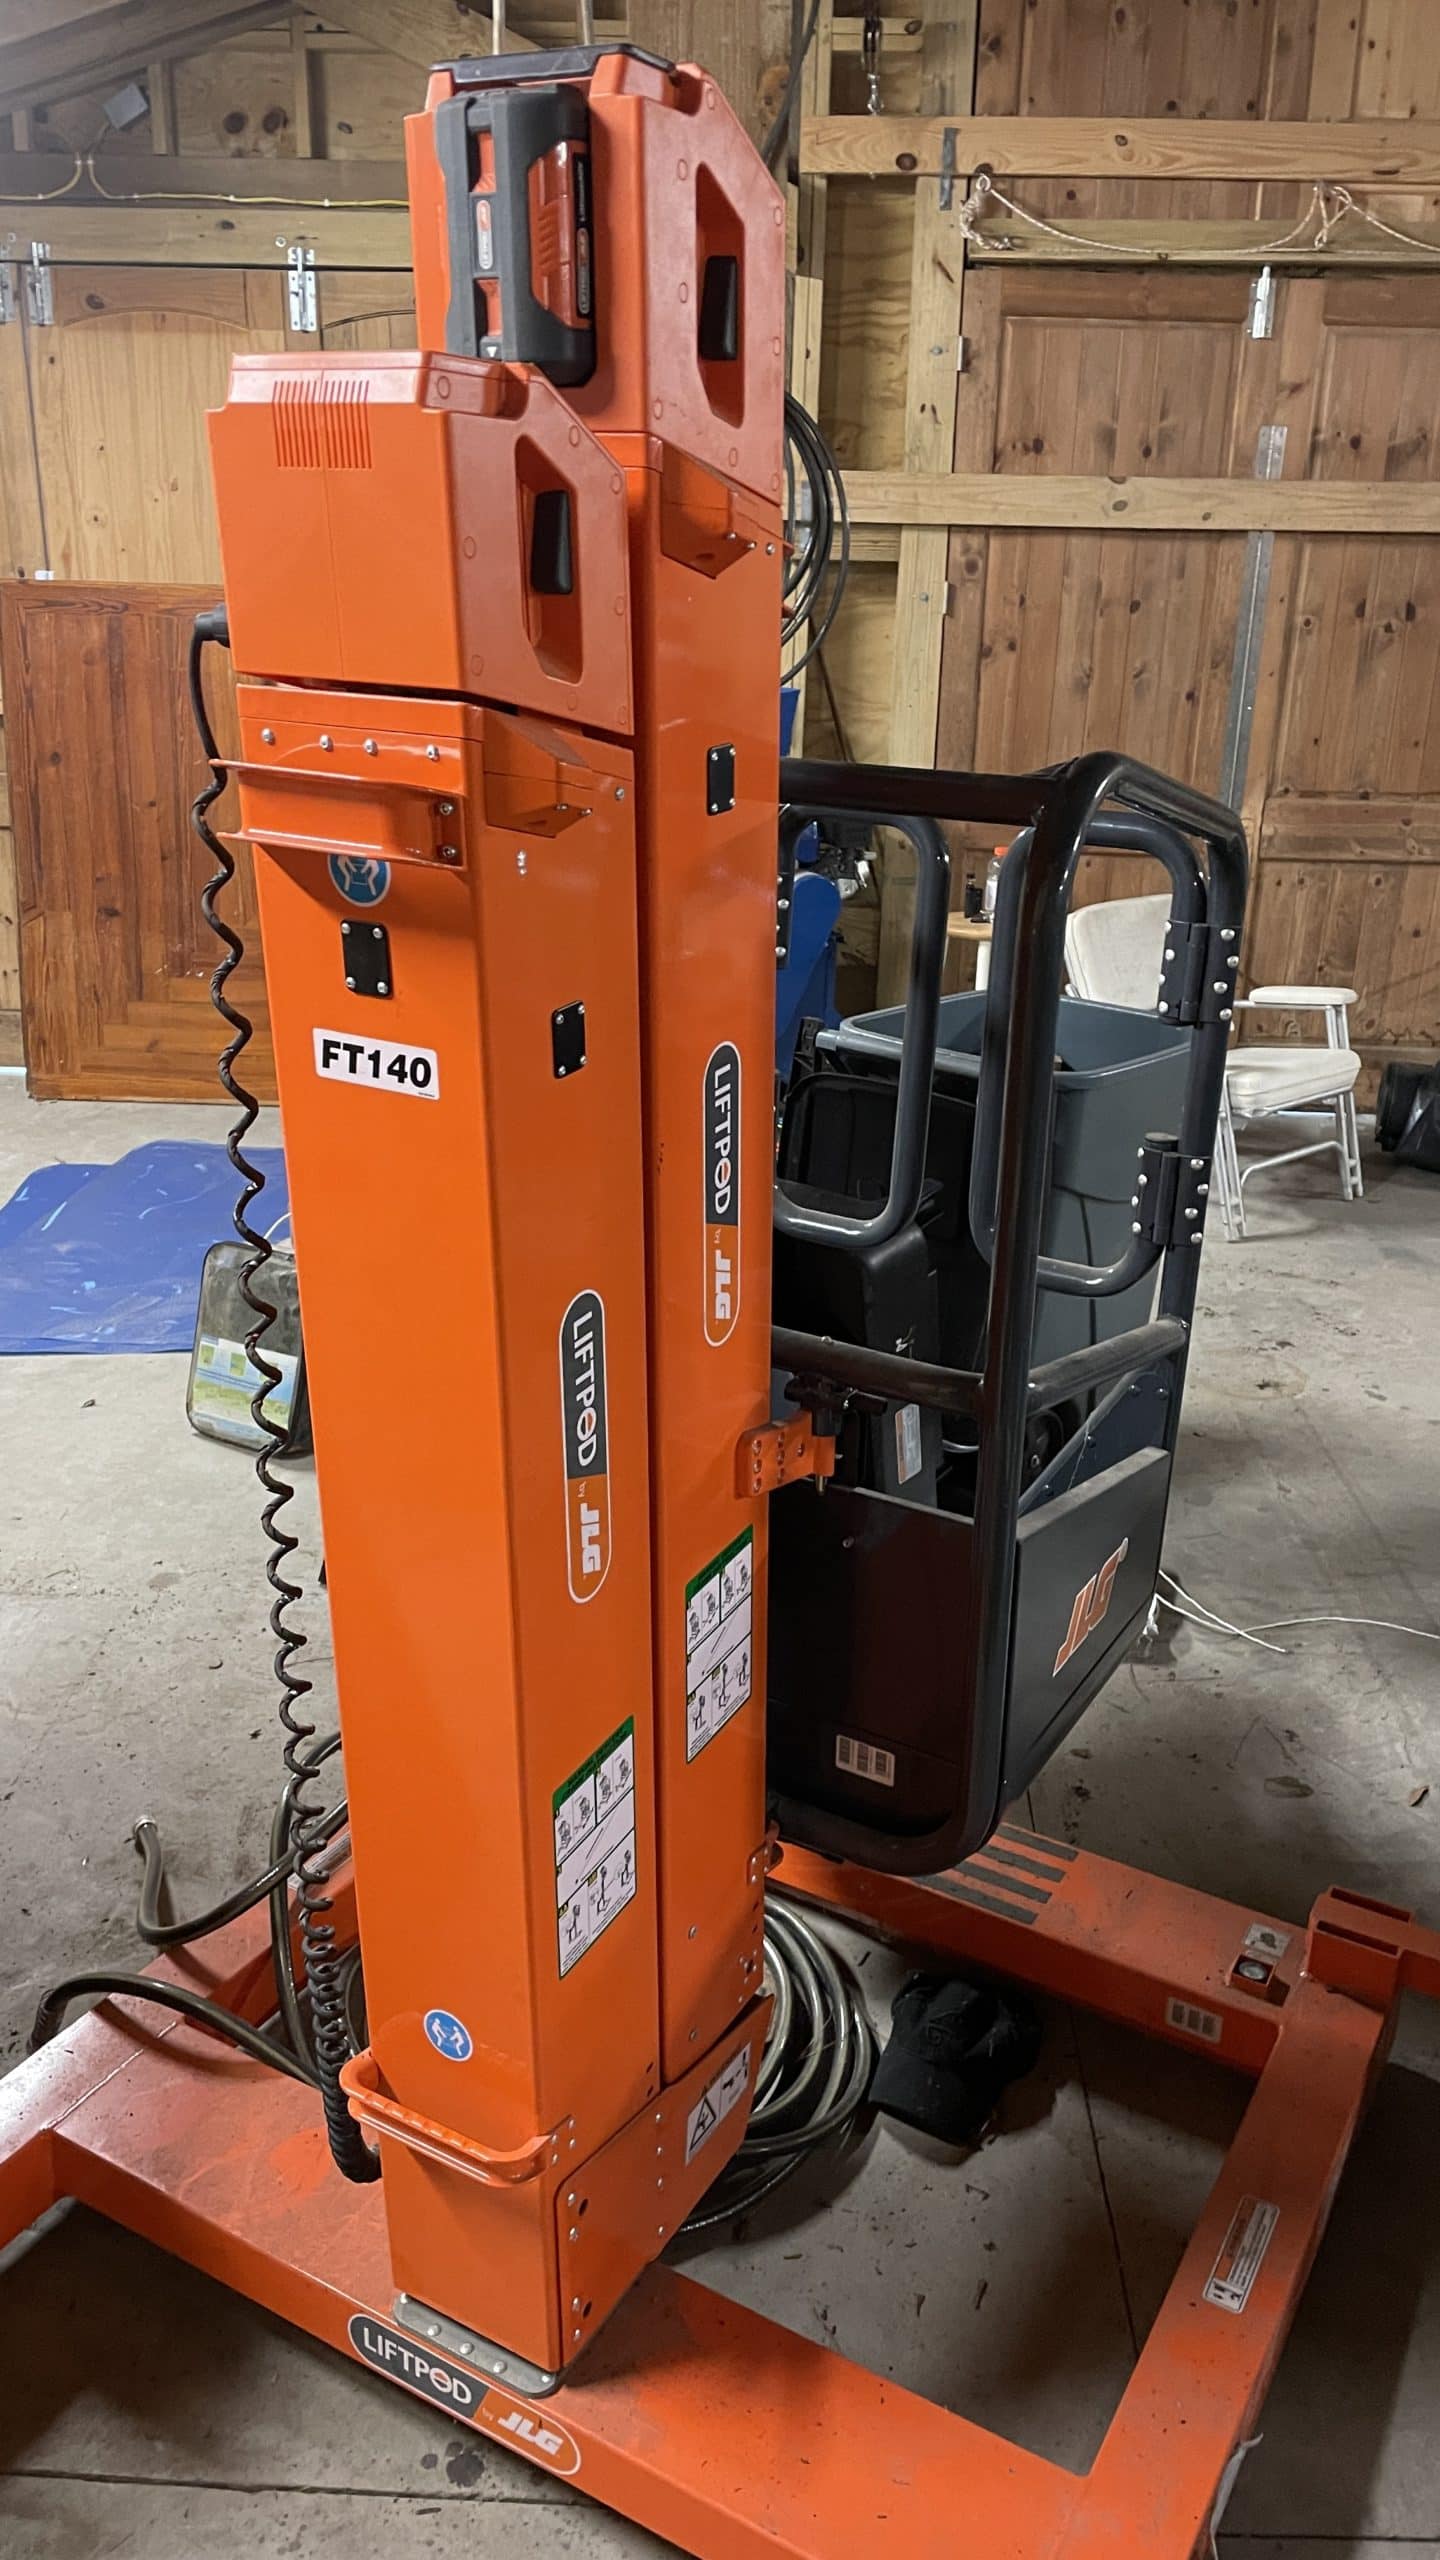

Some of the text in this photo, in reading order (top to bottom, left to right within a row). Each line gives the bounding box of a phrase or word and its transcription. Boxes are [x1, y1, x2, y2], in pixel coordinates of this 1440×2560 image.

[322, 1038, 431, 1088] FT140
[714, 1063, 731, 1215] LIFTPOD
[714, 1249, 731, 1320] JLG
[573, 1311, 597, 1467] LIFTPOD
[580, 1502, 601, 1575] JLG
[1053, 1548, 1121, 1678] JLG
[363, 2327, 472, 2405] LIFTPOD
[498, 2412, 564, 2456] JLG
